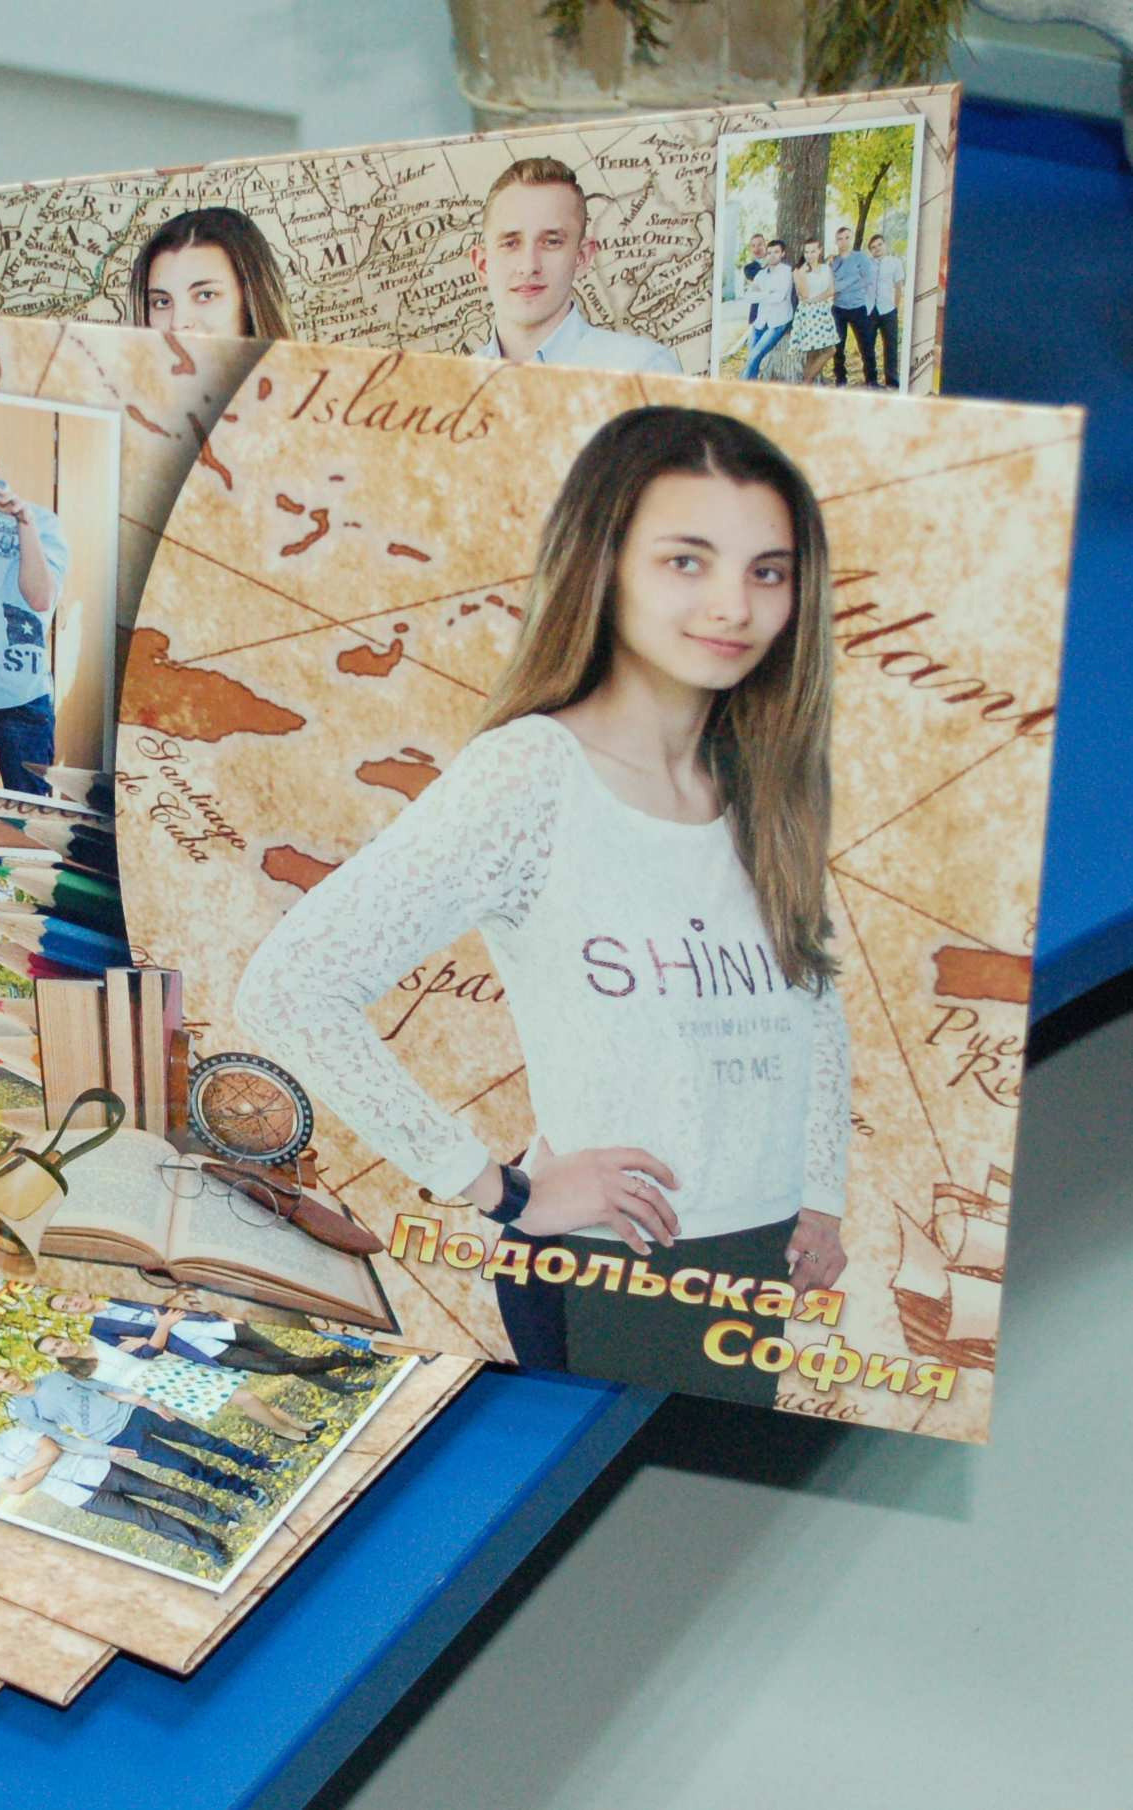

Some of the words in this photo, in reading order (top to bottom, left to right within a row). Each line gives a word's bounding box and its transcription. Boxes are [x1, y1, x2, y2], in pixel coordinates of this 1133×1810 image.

[397, 271, 478, 305] TARTARI
[288, 352, 515, 443] Islands
[136, 735, 248, 853] Santiago
[149, 791, 210, 864] Cuba
[381, 960, 505, 1041] spa
[712, 1057, 745, 1085] TO
[389, 1213, 846, 1327] Подольская
[703, 1320, 959, 1401] София
